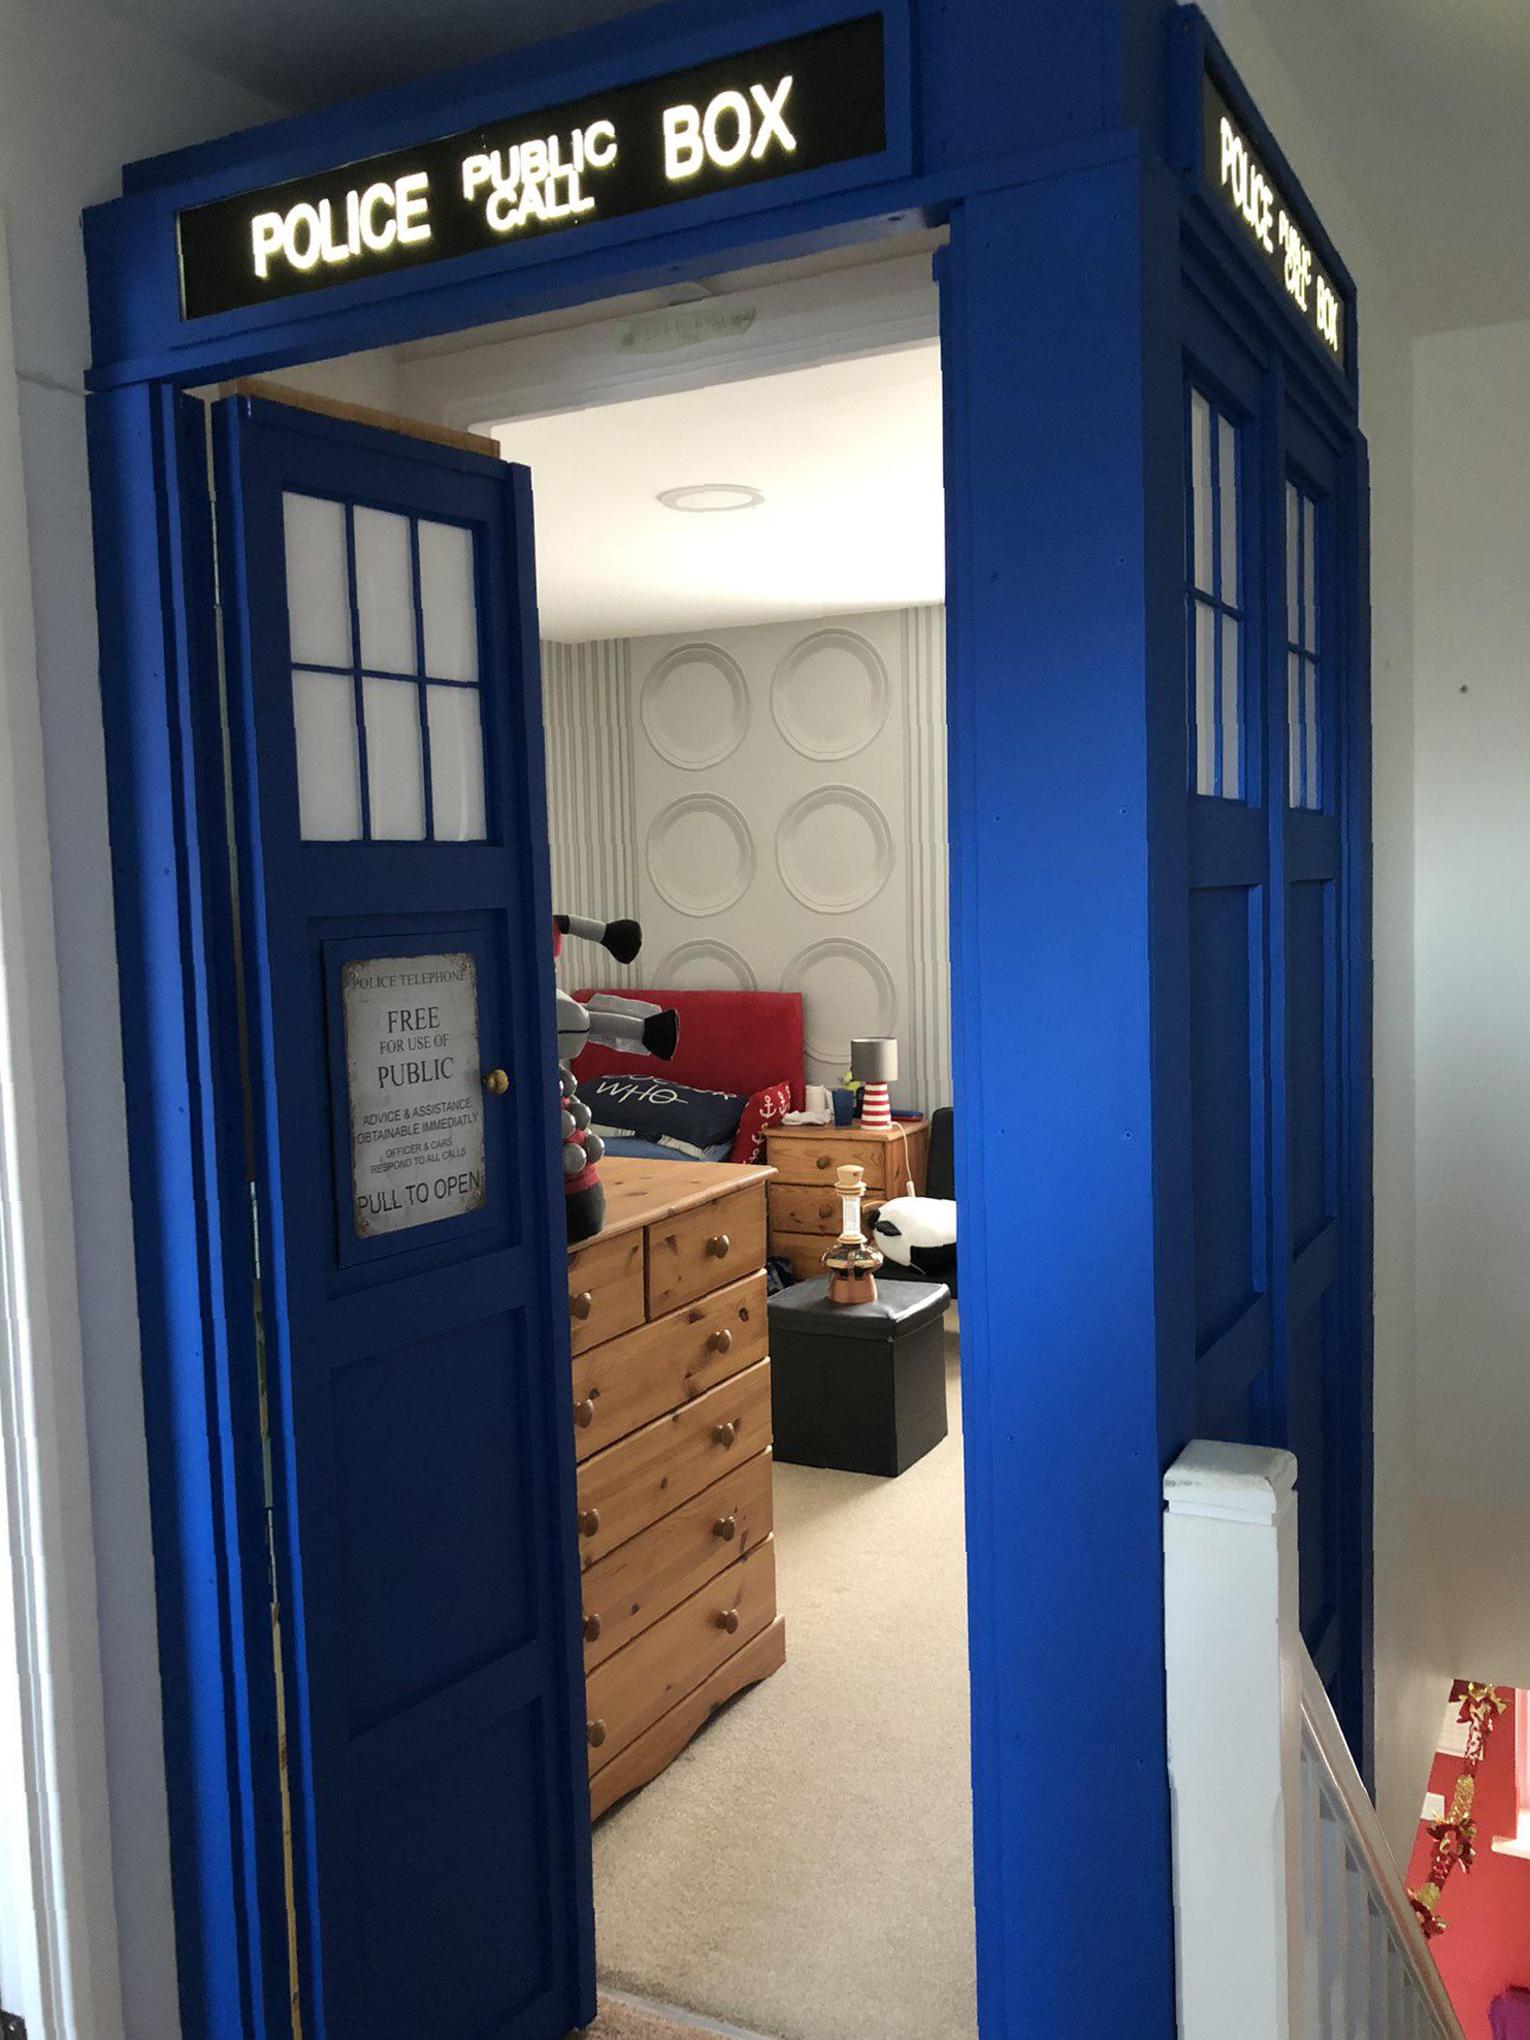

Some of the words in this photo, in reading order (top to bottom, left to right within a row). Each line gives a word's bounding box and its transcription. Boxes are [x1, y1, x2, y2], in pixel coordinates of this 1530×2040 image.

[663, 75, 797, 180] BOX
[463, 120, 618, 200] PUBLIC
[1220, 116, 1274, 254] POLICE
[485, 171, 596, 232] CALL
[252, 172, 431, 278] POLICE
[352, 974, 396, 990] POLICE
[400, 969, 467, 987] TELEPHONE
[387, 1006, 441, 1034] FREE
[379, 1038, 405, 1054] FOR
[408, 1035, 431, 1051] USE
[433, 1033, 450, 1048] OF
[377, 1056, 454, 1089] PUBLIC
[596, 1081, 689, 1104] WHO
[362, 1109, 400, 1127] ADVICE
[404, 1108, 411, 1120] &
[412, 1097, 473, 1118] ASSISTANCE
[356, 1123, 420, 1145] OBTAINABLE
[430, 1137, 453, 1150] CARS
[370, 1158, 412, 1174] RESPOND
[414, 1156, 425, 1167] TO
[425, 1153, 441, 1165] ALL
[441, 1147, 467, 1161] CALLS
[358, 1189, 402, 1214] PULL
[405, 1182, 429, 1205] TO
[434, 1169, 480, 1199] OPEN
